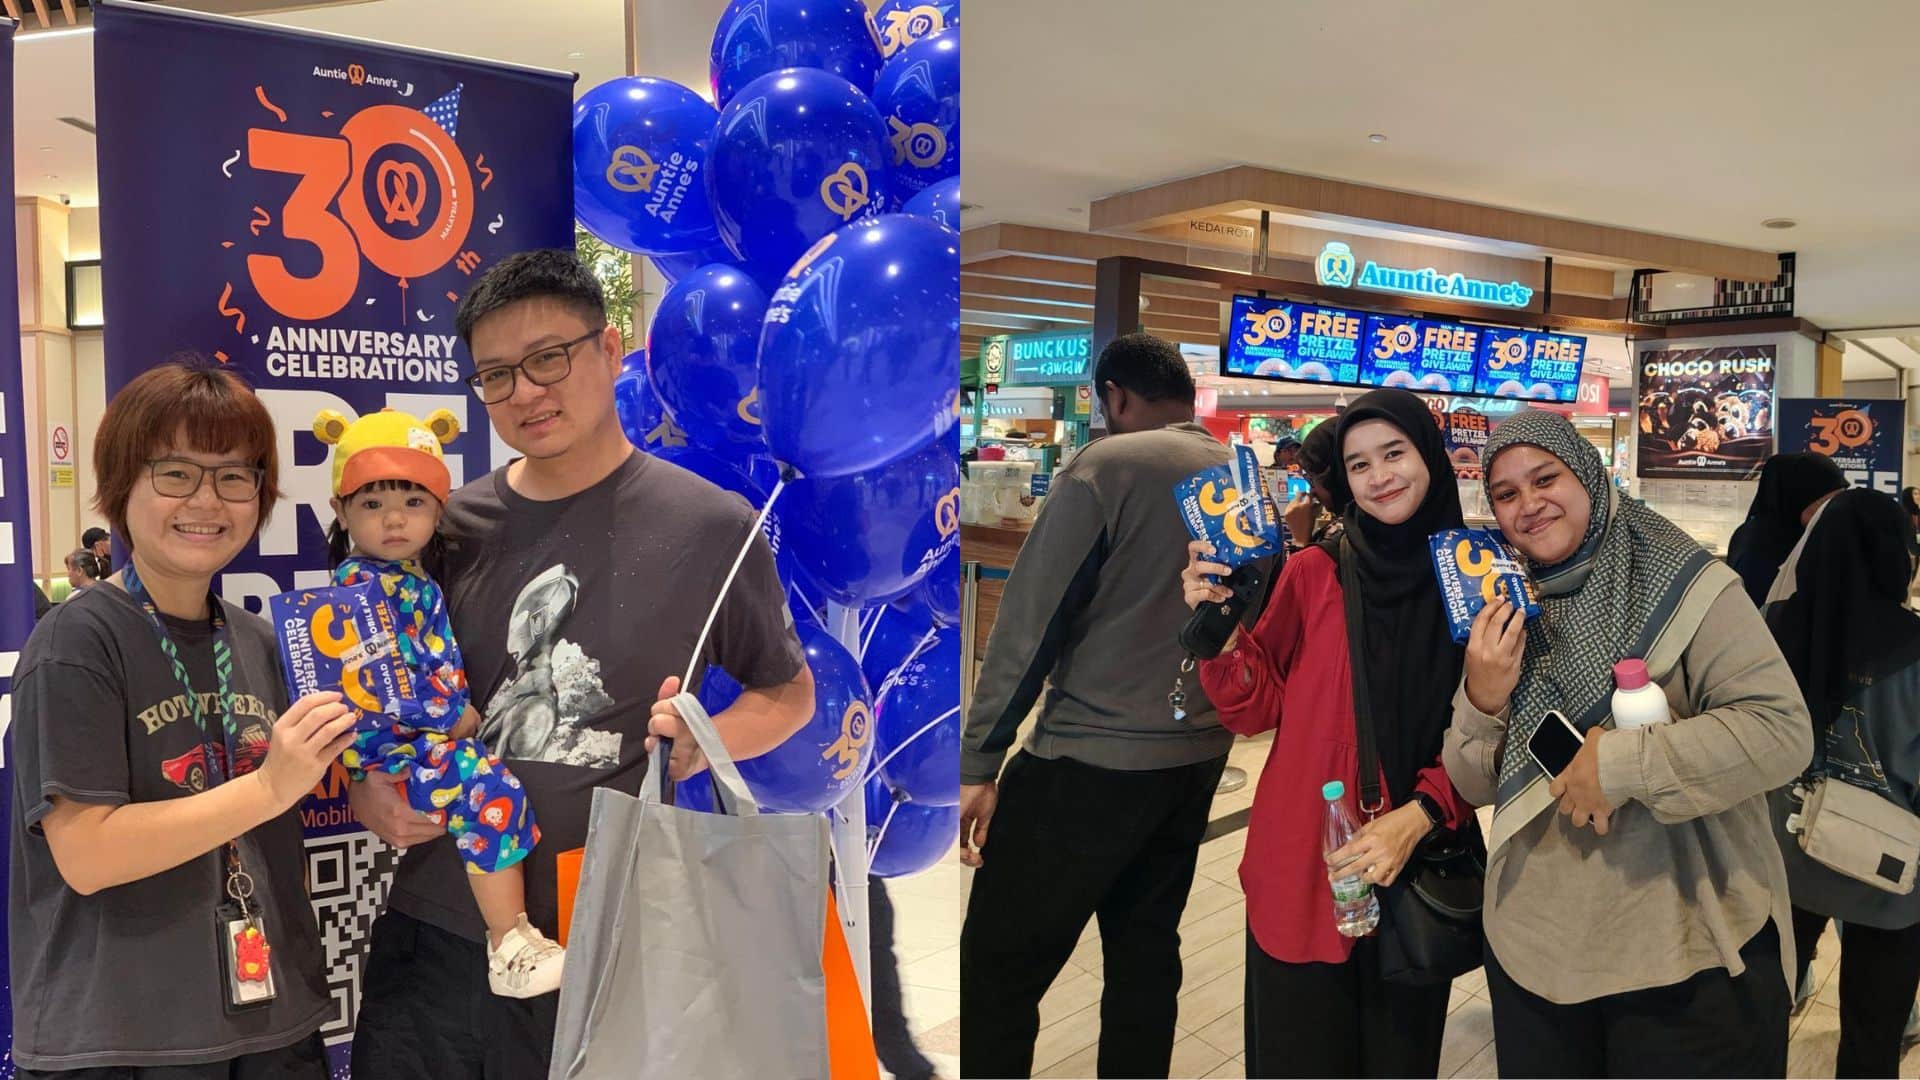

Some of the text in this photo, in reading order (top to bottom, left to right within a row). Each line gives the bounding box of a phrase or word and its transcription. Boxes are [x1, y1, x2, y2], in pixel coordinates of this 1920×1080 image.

[312, 65, 399, 89] Auntie Anne's
[644, 151, 685, 219] Auntie
[659, 159, 699, 225] Anne's
[248, 104, 475, 321] 30
[1189, 220, 1225, 235] KEDAI
[456, 250, 482, 275] th
[1242, 308, 1293, 346] 30
[1299, 311, 1361, 340] FREE
[266, 326, 457, 358] ANNIVERSARY
[1012, 338, 1089, 361] BUNGKUS
[1297, 334, 1357, 352] PRETZEL
[1374, 324, 1418, 360] 30
[1423, 327, 1478, 352] FREE
[1533, 339, 1582, 362] FREE
[1297, 346, 1357, 361] GIVEAWAY
[1420, 359, 1473, 372] GIVEAWAY
[1421, 347, 1473, 364] PRETZEL
[1488, 336, 1528, 371] 30
[1530, 358, 1577, 374] PRETZEL
[1644, 357, 1772, 377] CHOCO RUSH
[266, 353, 460, 383] CELEBRATIONS
[1529, 369, 1576, 382] GIVEAWAY
[1449, 413, 1488, 431] FREE
[1451, 428, 1488, 439] PRETZEL
[1808, 409, 1873, 456] 30
[1435, 548, 1462, 625] CELEBRATIONS
[1443, 548, 1471, 621] ANNIVERSARY
[375, 600, 401, 658] PRETZEL
[393, 667, 413, 700] FREE
[136, 694, 193, 736] HOT
[822, 700, 871, 780] 30
[300, 804, 352, 829] Mobil
